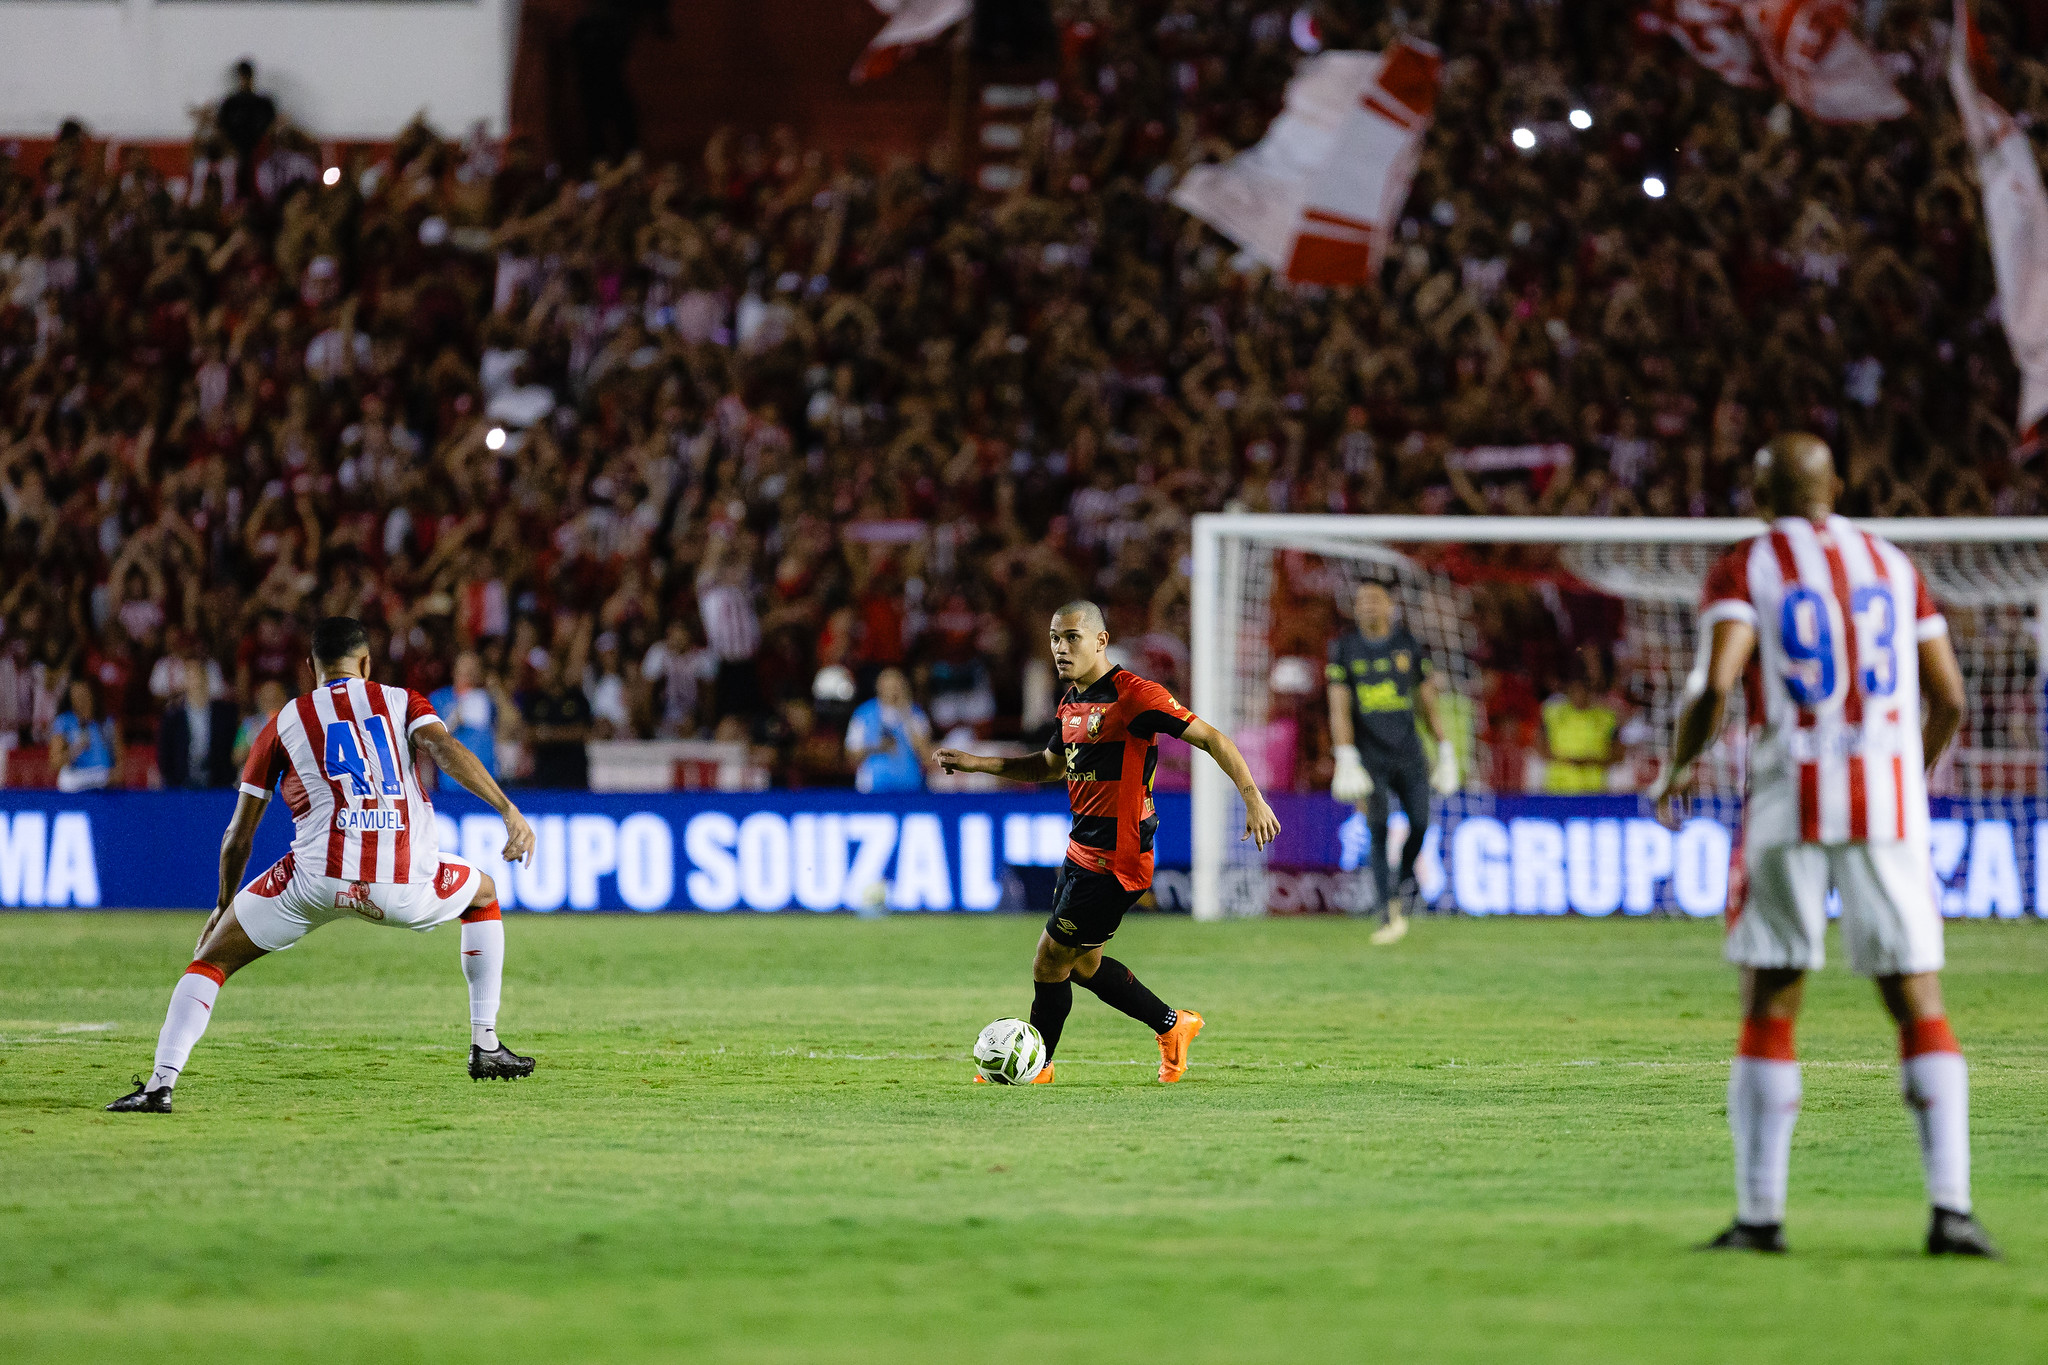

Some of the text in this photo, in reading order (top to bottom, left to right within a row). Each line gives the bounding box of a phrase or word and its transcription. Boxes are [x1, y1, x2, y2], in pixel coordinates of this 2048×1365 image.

[1781, 586, 1898, 704] 93
[325, 715, 404, 798] 41
[336, 809, 405, 830] SAMUEL
[685, 811, 954, 912] SOUZA
[1452, 816, 1732, 918] GRUPO
